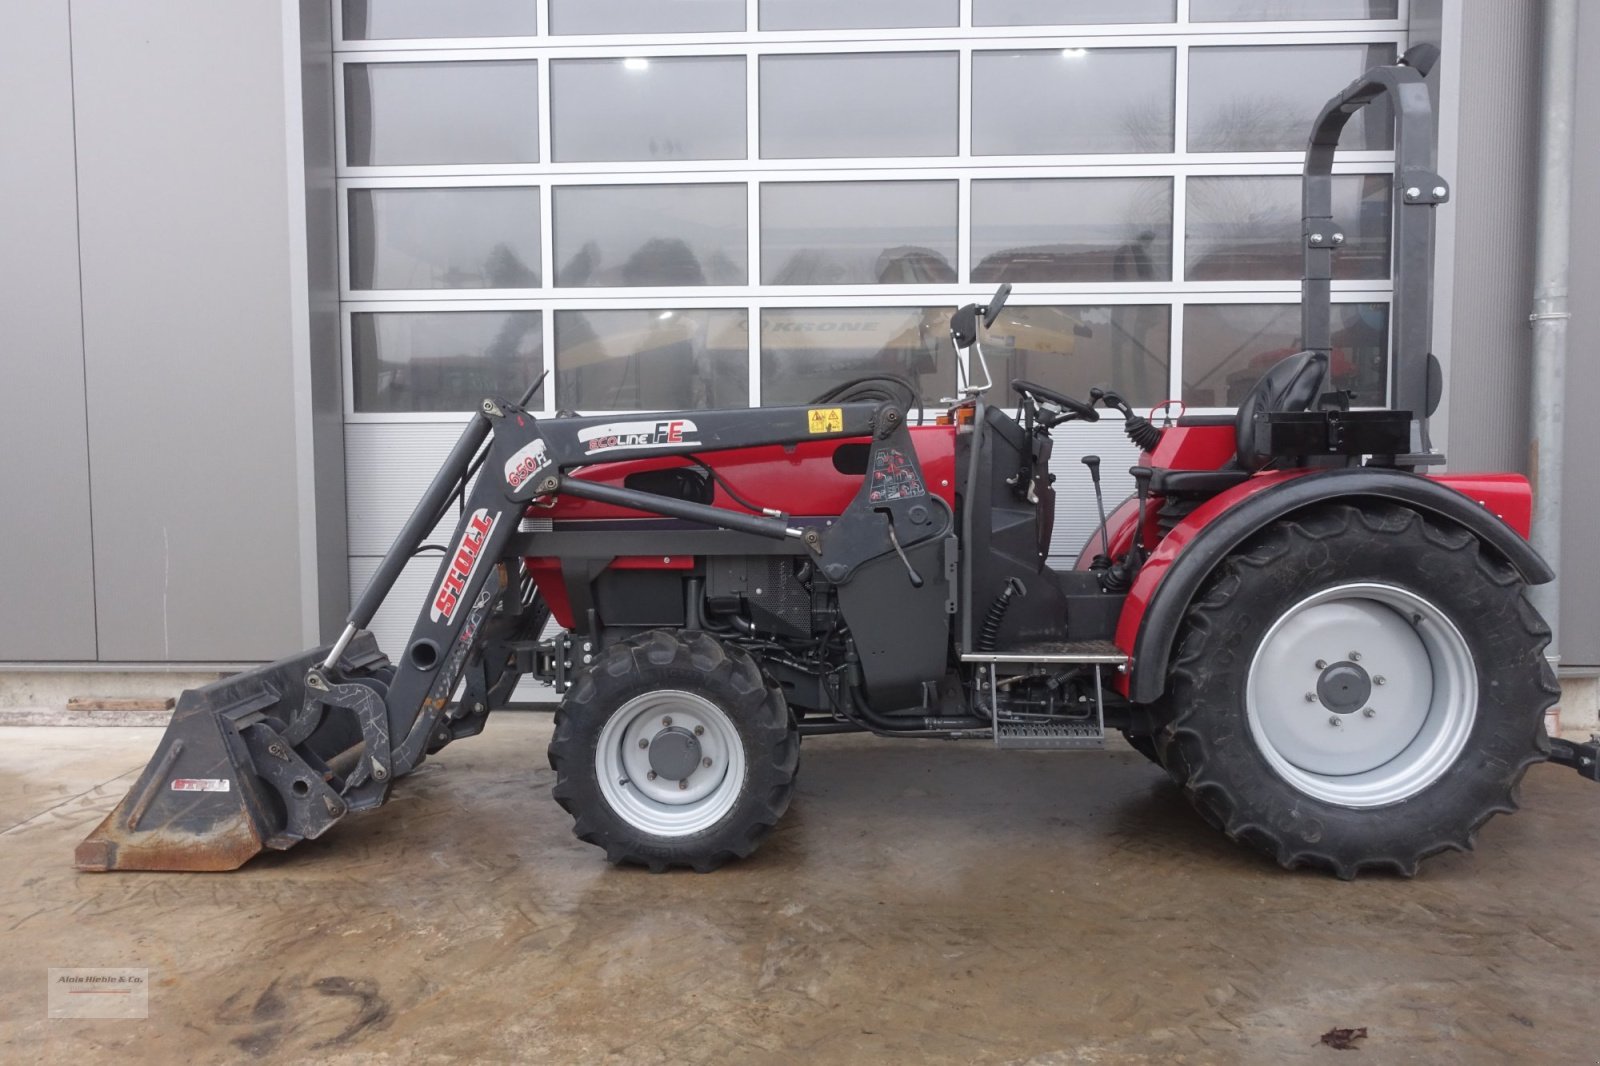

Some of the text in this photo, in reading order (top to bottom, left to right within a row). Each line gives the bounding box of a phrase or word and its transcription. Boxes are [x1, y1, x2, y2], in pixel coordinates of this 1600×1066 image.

[653, 421, 684, 444] FE
[508, 456, 537, 487] 650
[435, 514, 493, 618] STOLL
